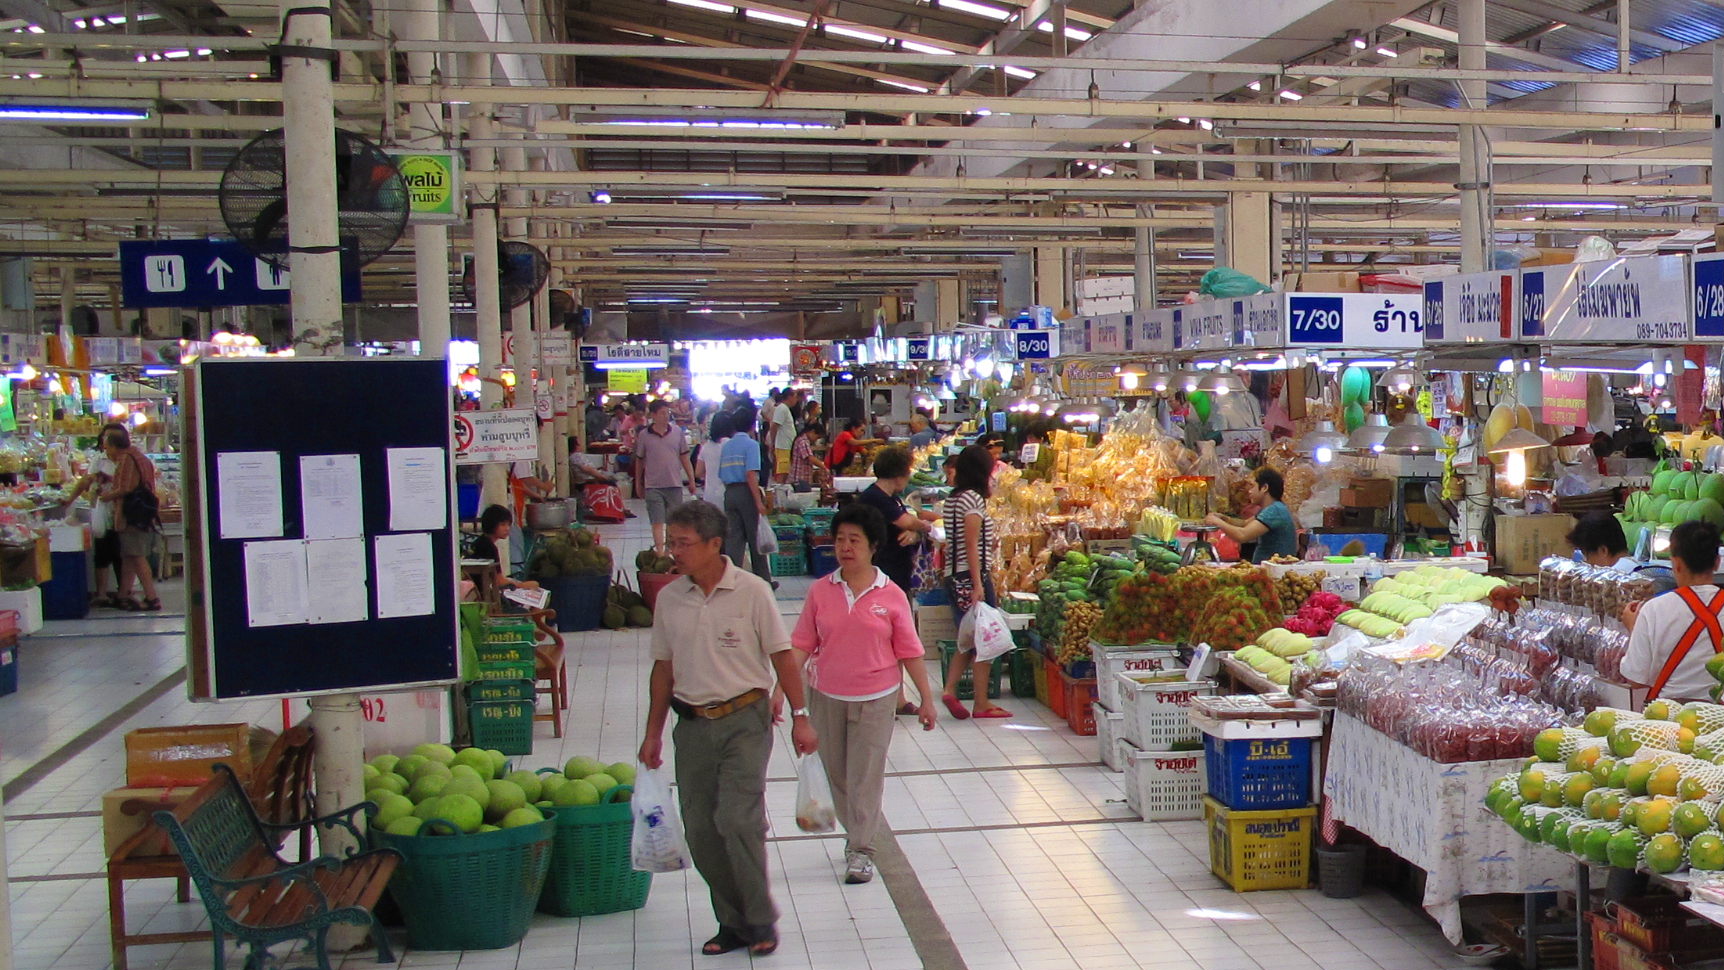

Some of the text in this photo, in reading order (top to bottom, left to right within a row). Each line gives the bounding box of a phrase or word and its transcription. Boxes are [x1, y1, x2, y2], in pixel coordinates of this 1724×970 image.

[412, 189, 441, 203] ruits
[1524, 292, 1543, 321] 6/27
[1696, 282, 1724, 319] 6/28
[1292, 309, 1341, 332] 7/30
[1636, 321, 1688, 339] 089-7043734
[1018, 339, 1048, 353] 8/30
